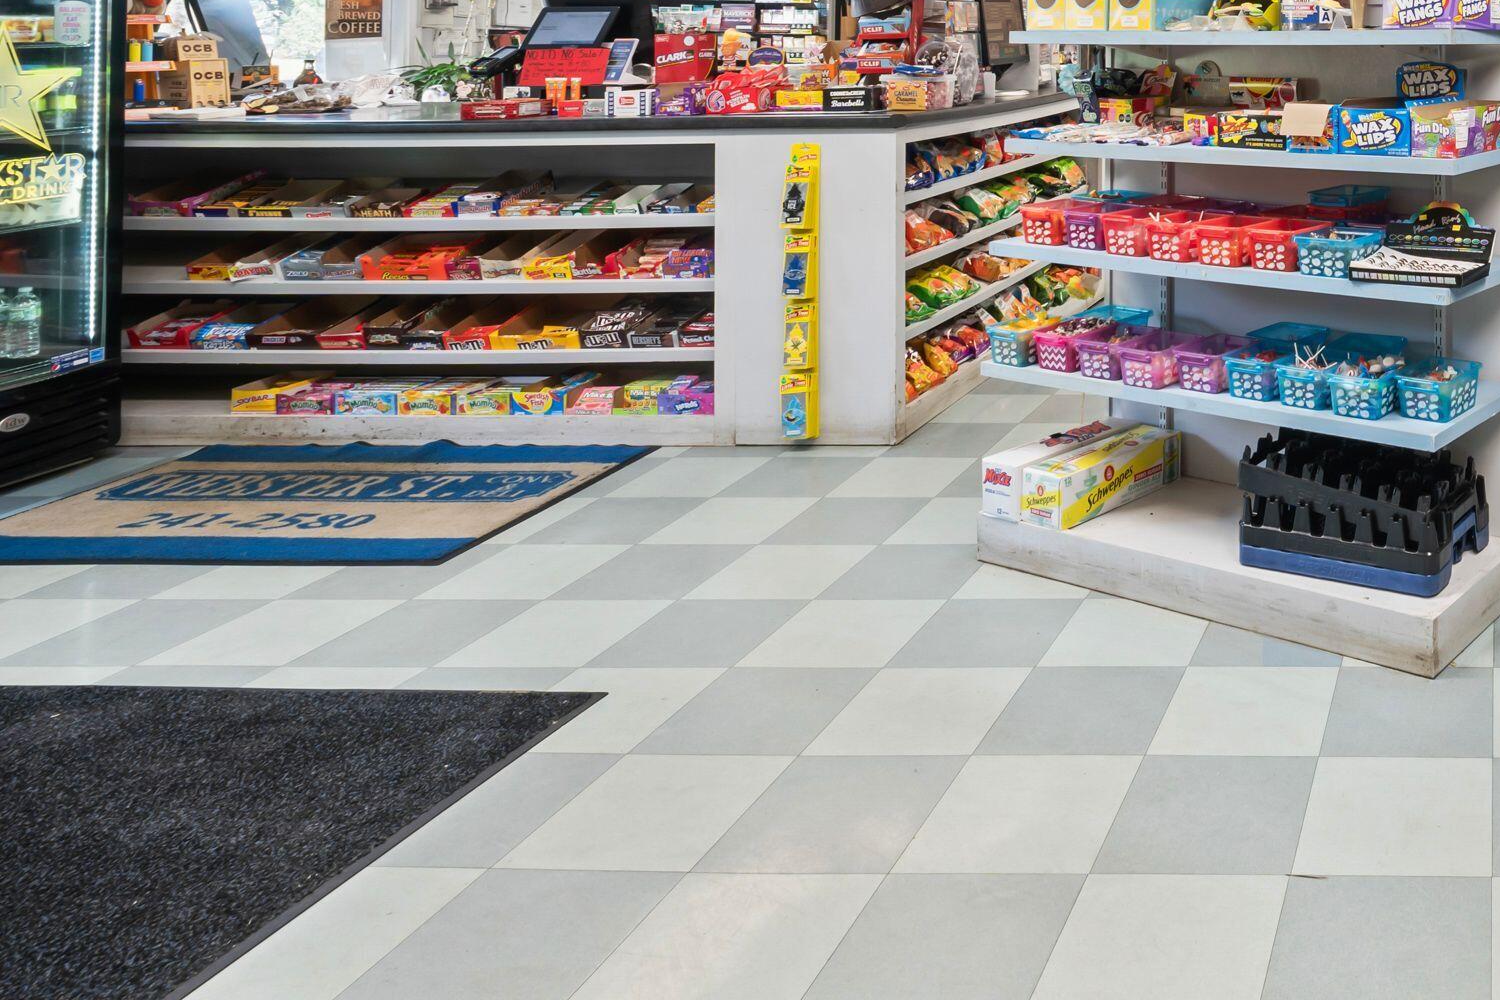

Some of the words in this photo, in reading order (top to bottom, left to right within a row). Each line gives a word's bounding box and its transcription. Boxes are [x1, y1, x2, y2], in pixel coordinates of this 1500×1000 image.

[338, 10, 381, 20] BREWED
[1398, 1, 1444, 25] FANGS
[1462, 1, 1488, 18] FANGS
[328, 21, 381, 34] COFFEE
[182, 44, 213, 52] OCB
[562, 50, 574, 58] NO
[656, 52, 688, 64] CLARK
[193, 71, 224, 80] OCB
[1403, 69, 1449, 85] WAX
[1408, 81, 1451, 97] LIPS
[831, 99, 865, 108] Barebells
[1482, 109, 1497, 128] Fun
[1351, 117, 1395, 135] WAX
[1414, 121, 1431, 135] Fun
[1432, 122, 1450, 138] Dip
[1356, 130, 1397, 147] LIPS
[787, 202, 797, 210] ICE
[361, 209, 392, 217] HEATH
[632, 336, 661, 345] HERSHEY'S
[682, 337, 702, 345] Peanut
[524, 392, 550, 402] Swedish
[530, 398, 544, 407] Fish
[290, 400, 319, 411] Mamba
[350, 399, 378, 408] Mamba
[411, 400, 438, 411] Mamba
[469, 399, 497, 409] Mamba
[122, 473, 390, 497] WEBSTER
[372, 475, 474, 498] ST.
[1086, 464, 1134, 513] Schweppes
[1026, 494, 1057, 509] Schweppes
[117, 512, 377, 530] 241-2580
